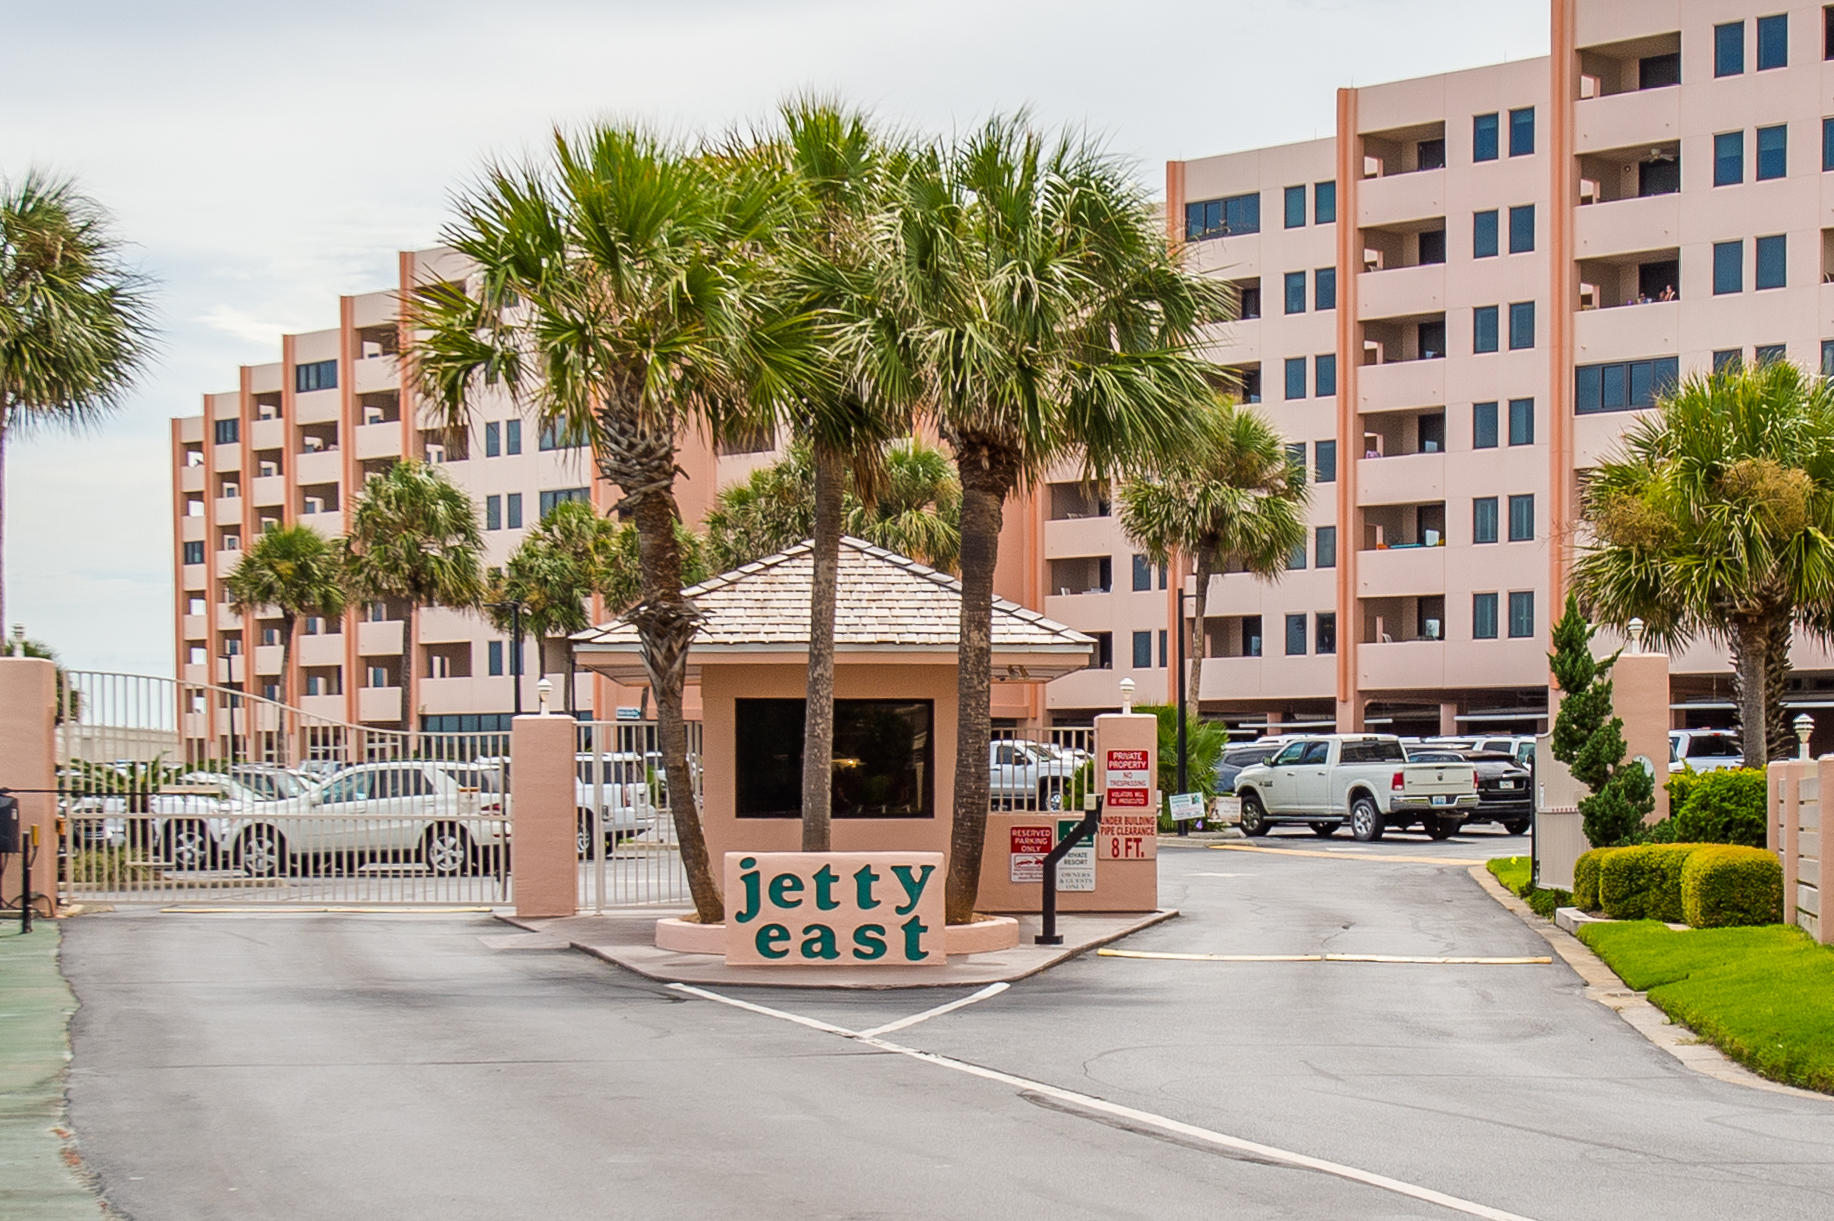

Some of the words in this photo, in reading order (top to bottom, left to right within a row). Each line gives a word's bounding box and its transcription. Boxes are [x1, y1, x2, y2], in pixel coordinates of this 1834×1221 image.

[1112, 752, 1142, 760] PRIVATE
[1108, 761, 1147, 769] PROPERTY
[1101, 816, 1122, 825] UNDER
[1124, 816, 1155, 825] BUILDING
[1012, 829, 1051, 837] RESERVED
[1100, 826, 1114, 836] PIPE
[1116, 826, 1155, 836] CLEARANCE
[1014, 837, 1048, 845] PARKING
[1111, 838, 1120, 858] 8
[1125, 837, 1144, 858] FT.
[735, 856, 936, 923] jetty
[755, 915, 929, 961] east
